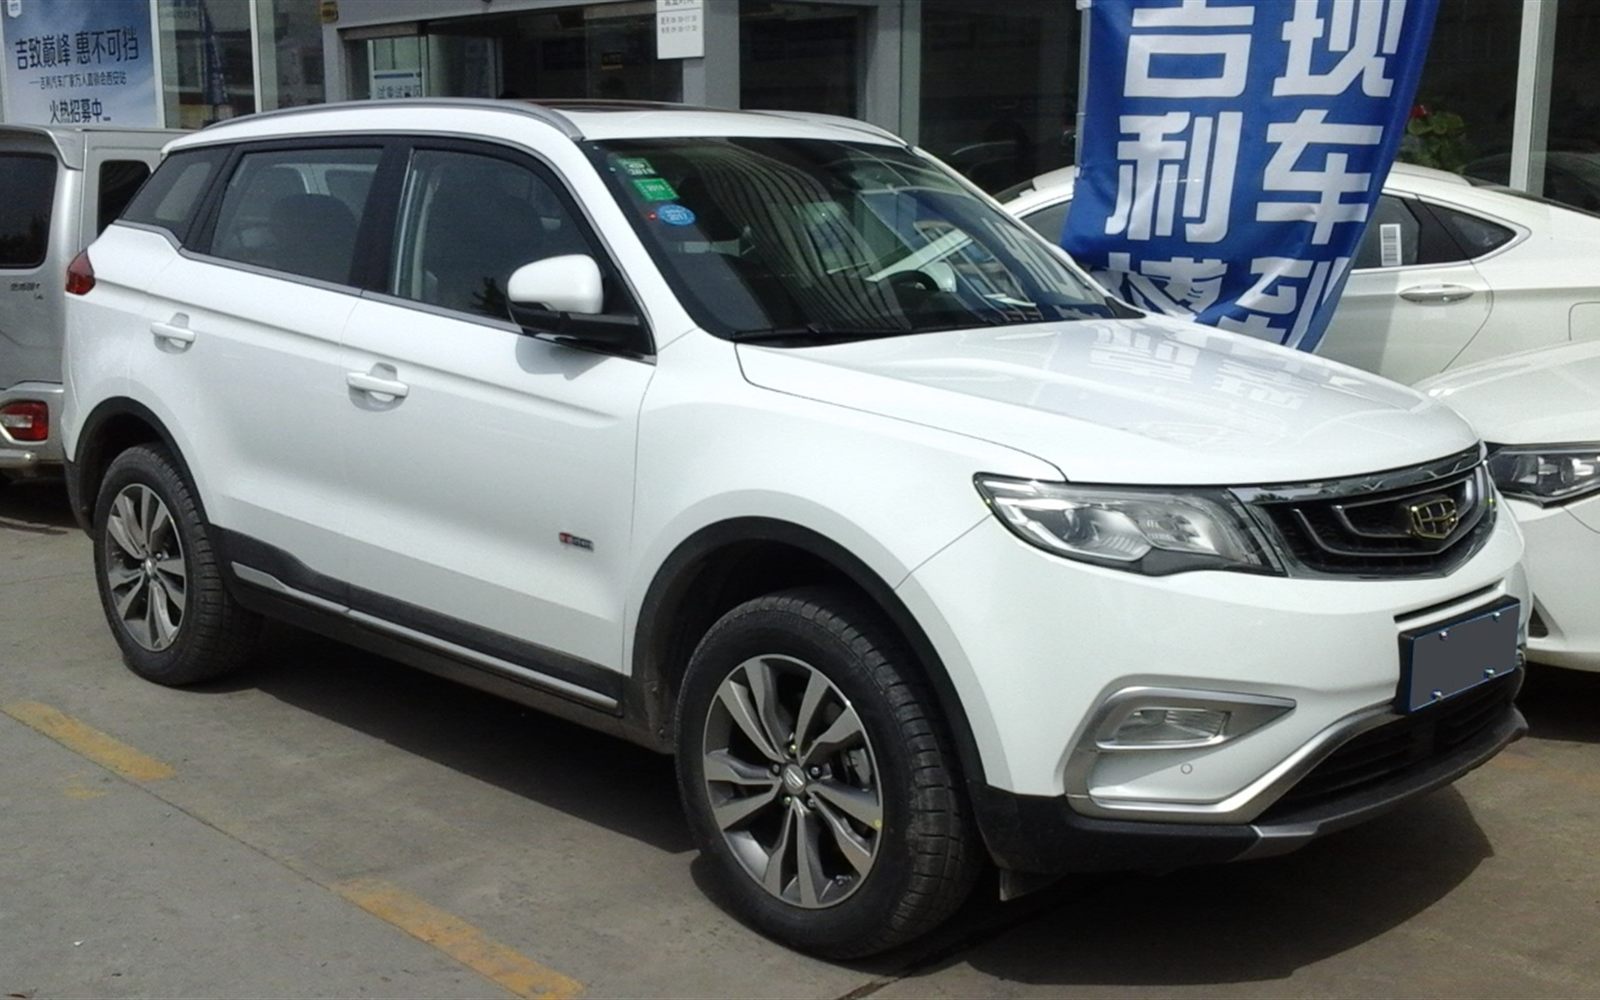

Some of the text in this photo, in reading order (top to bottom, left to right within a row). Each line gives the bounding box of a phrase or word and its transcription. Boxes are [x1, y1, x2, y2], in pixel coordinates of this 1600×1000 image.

[15, 27, 139, 70] 吉致巅峰 惠不可挡
